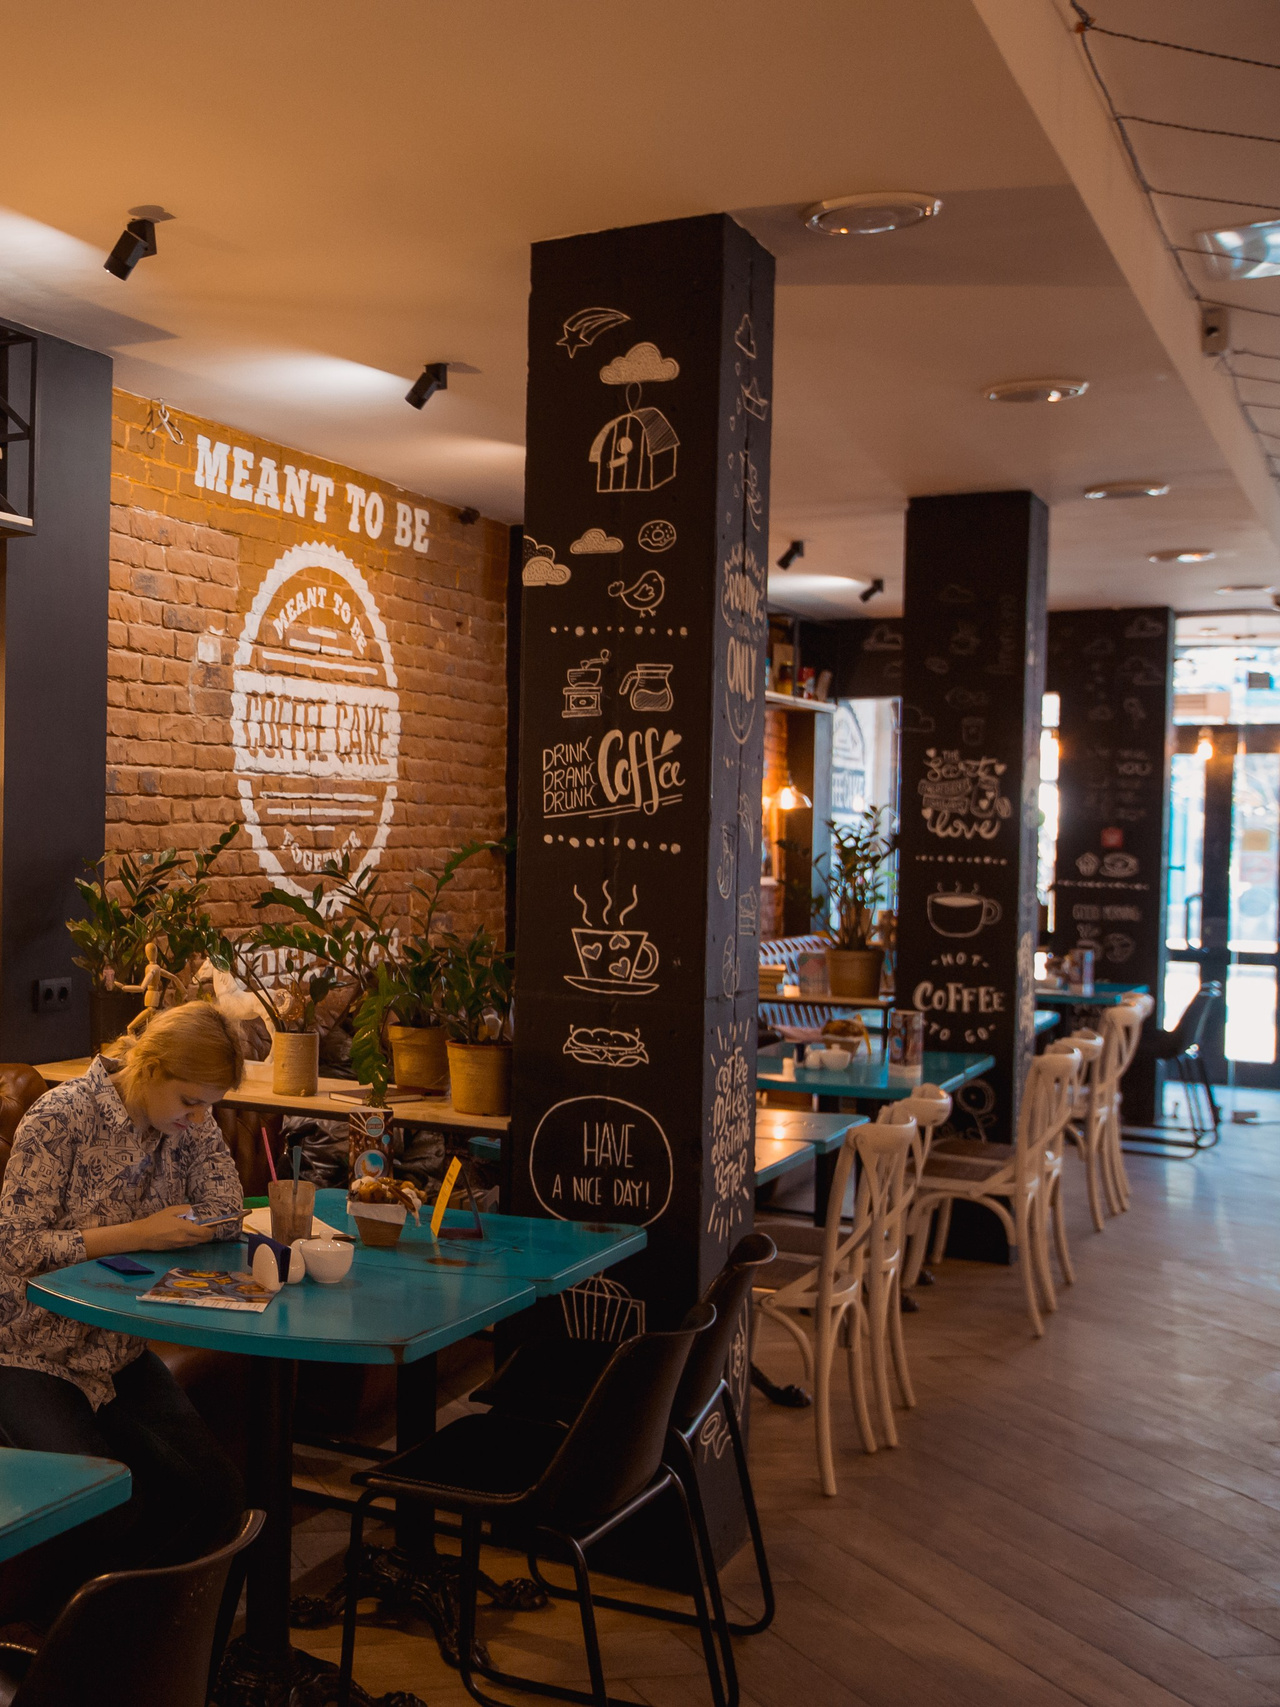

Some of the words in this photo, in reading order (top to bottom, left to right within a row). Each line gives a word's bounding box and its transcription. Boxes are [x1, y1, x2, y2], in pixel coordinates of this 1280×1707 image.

[194, 433, 335, 524] MEANT
[345, 482, 386, 541] TO
[394, 501, 431, 554] BE
[272, 586, 328, 641] MEANT
[333, 592, 352, 625] TO
[350, 616, 368, 655] BE
[727, 636, 758, 703] ONLY
[243, 691, 330, 762] COFFEE
[335, 700, 391, 766] CAKE
[543, 736, 592, 771] DRINK
[598, 727, 686, 815] Coffee
[543, 762, 598, 793] DRANK
[543, 785, 598, 813] DRUNK
[927, 810, 1001, 840] love
[929, 1022, 951, 1041] TO
[964, 1027, 990, 1044] GO
[583, 1121, 636, 1168] HAVE
[552, 1174, 563, 1200] A
[573, 1176, 602, 1205] NICE
[613, 1178, 650, 1210] DAY!
